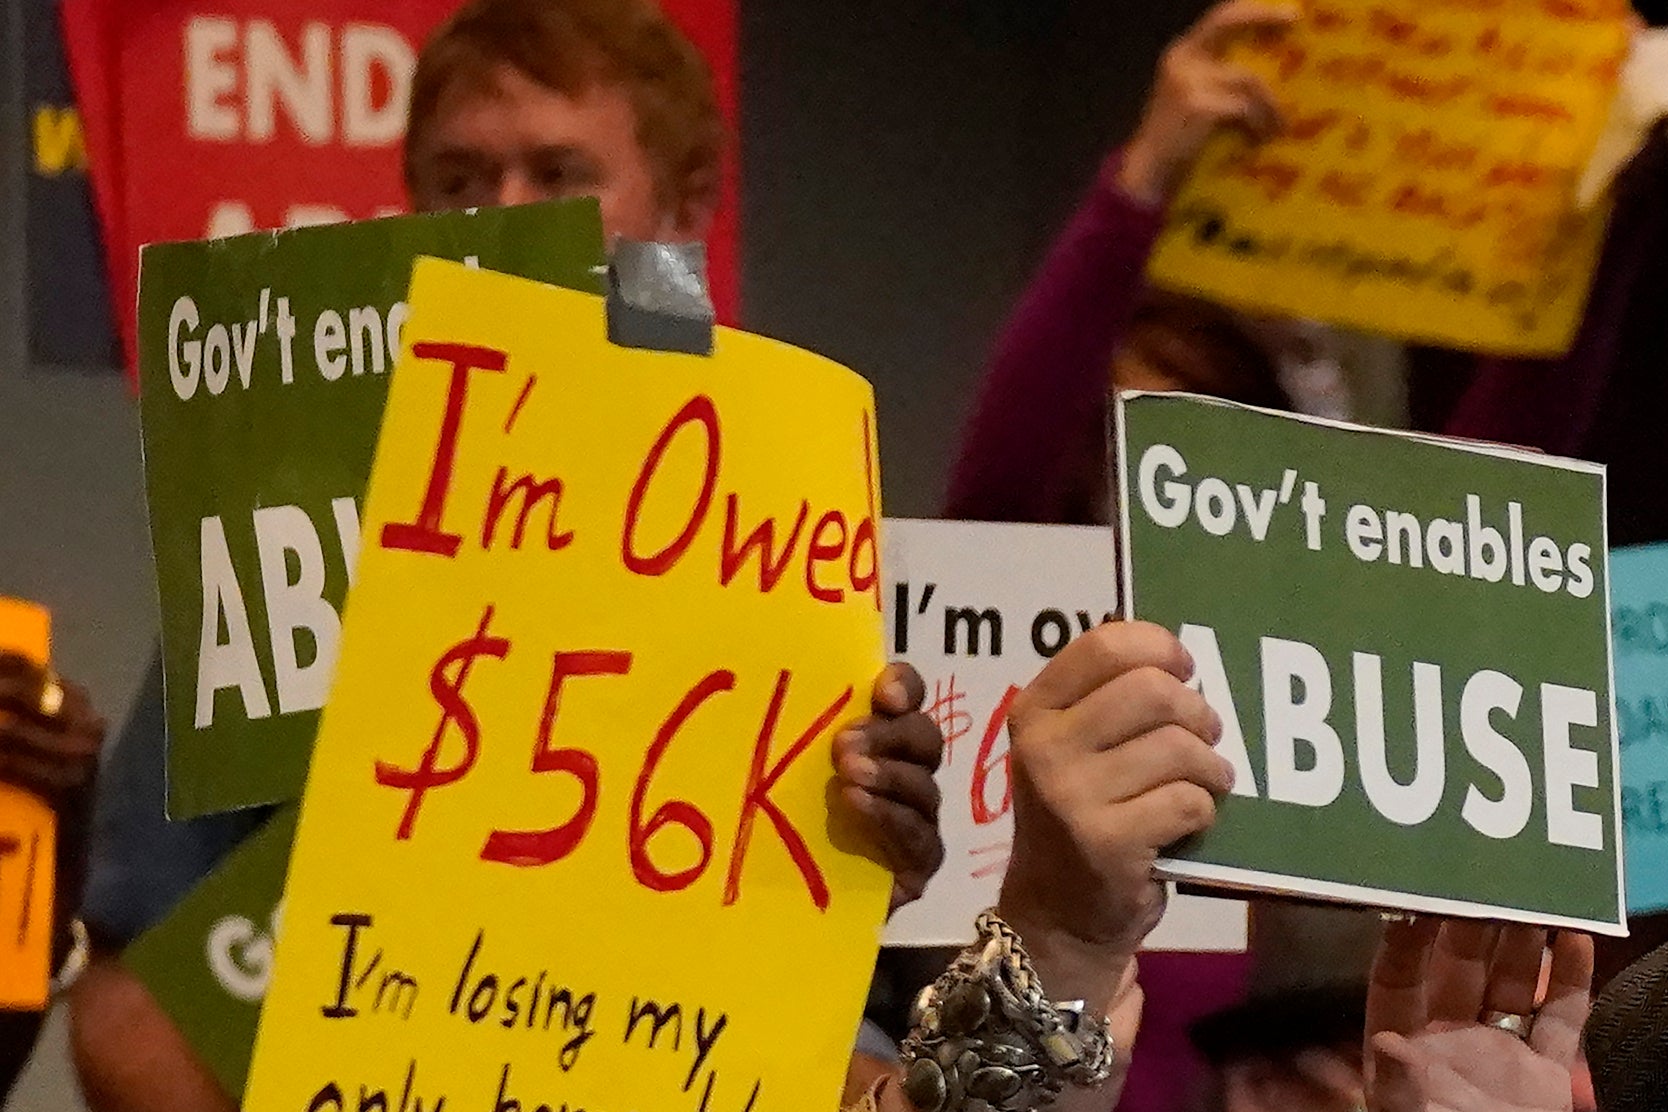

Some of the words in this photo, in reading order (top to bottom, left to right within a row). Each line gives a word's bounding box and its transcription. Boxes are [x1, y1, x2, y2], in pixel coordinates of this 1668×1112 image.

[184, 15, 420, 148] END
[167, 286, 296, 401] Gov't
[380, 341, 576, 558] I'm
[620, 394, 882, 613] Owed
[1137, 443, 1328, 552] Gov't
[1345, 493, 1596, 600] enables
[894, 581, 1003, 657] I'm
[374, 605, 855, 912] $56K
[1172, 622, 1606, 852] ABUSE
[320, 913, 420, 1020] I'm
[449, 928, 597, 1071] losing
[624, 997, 728, 1091] my
